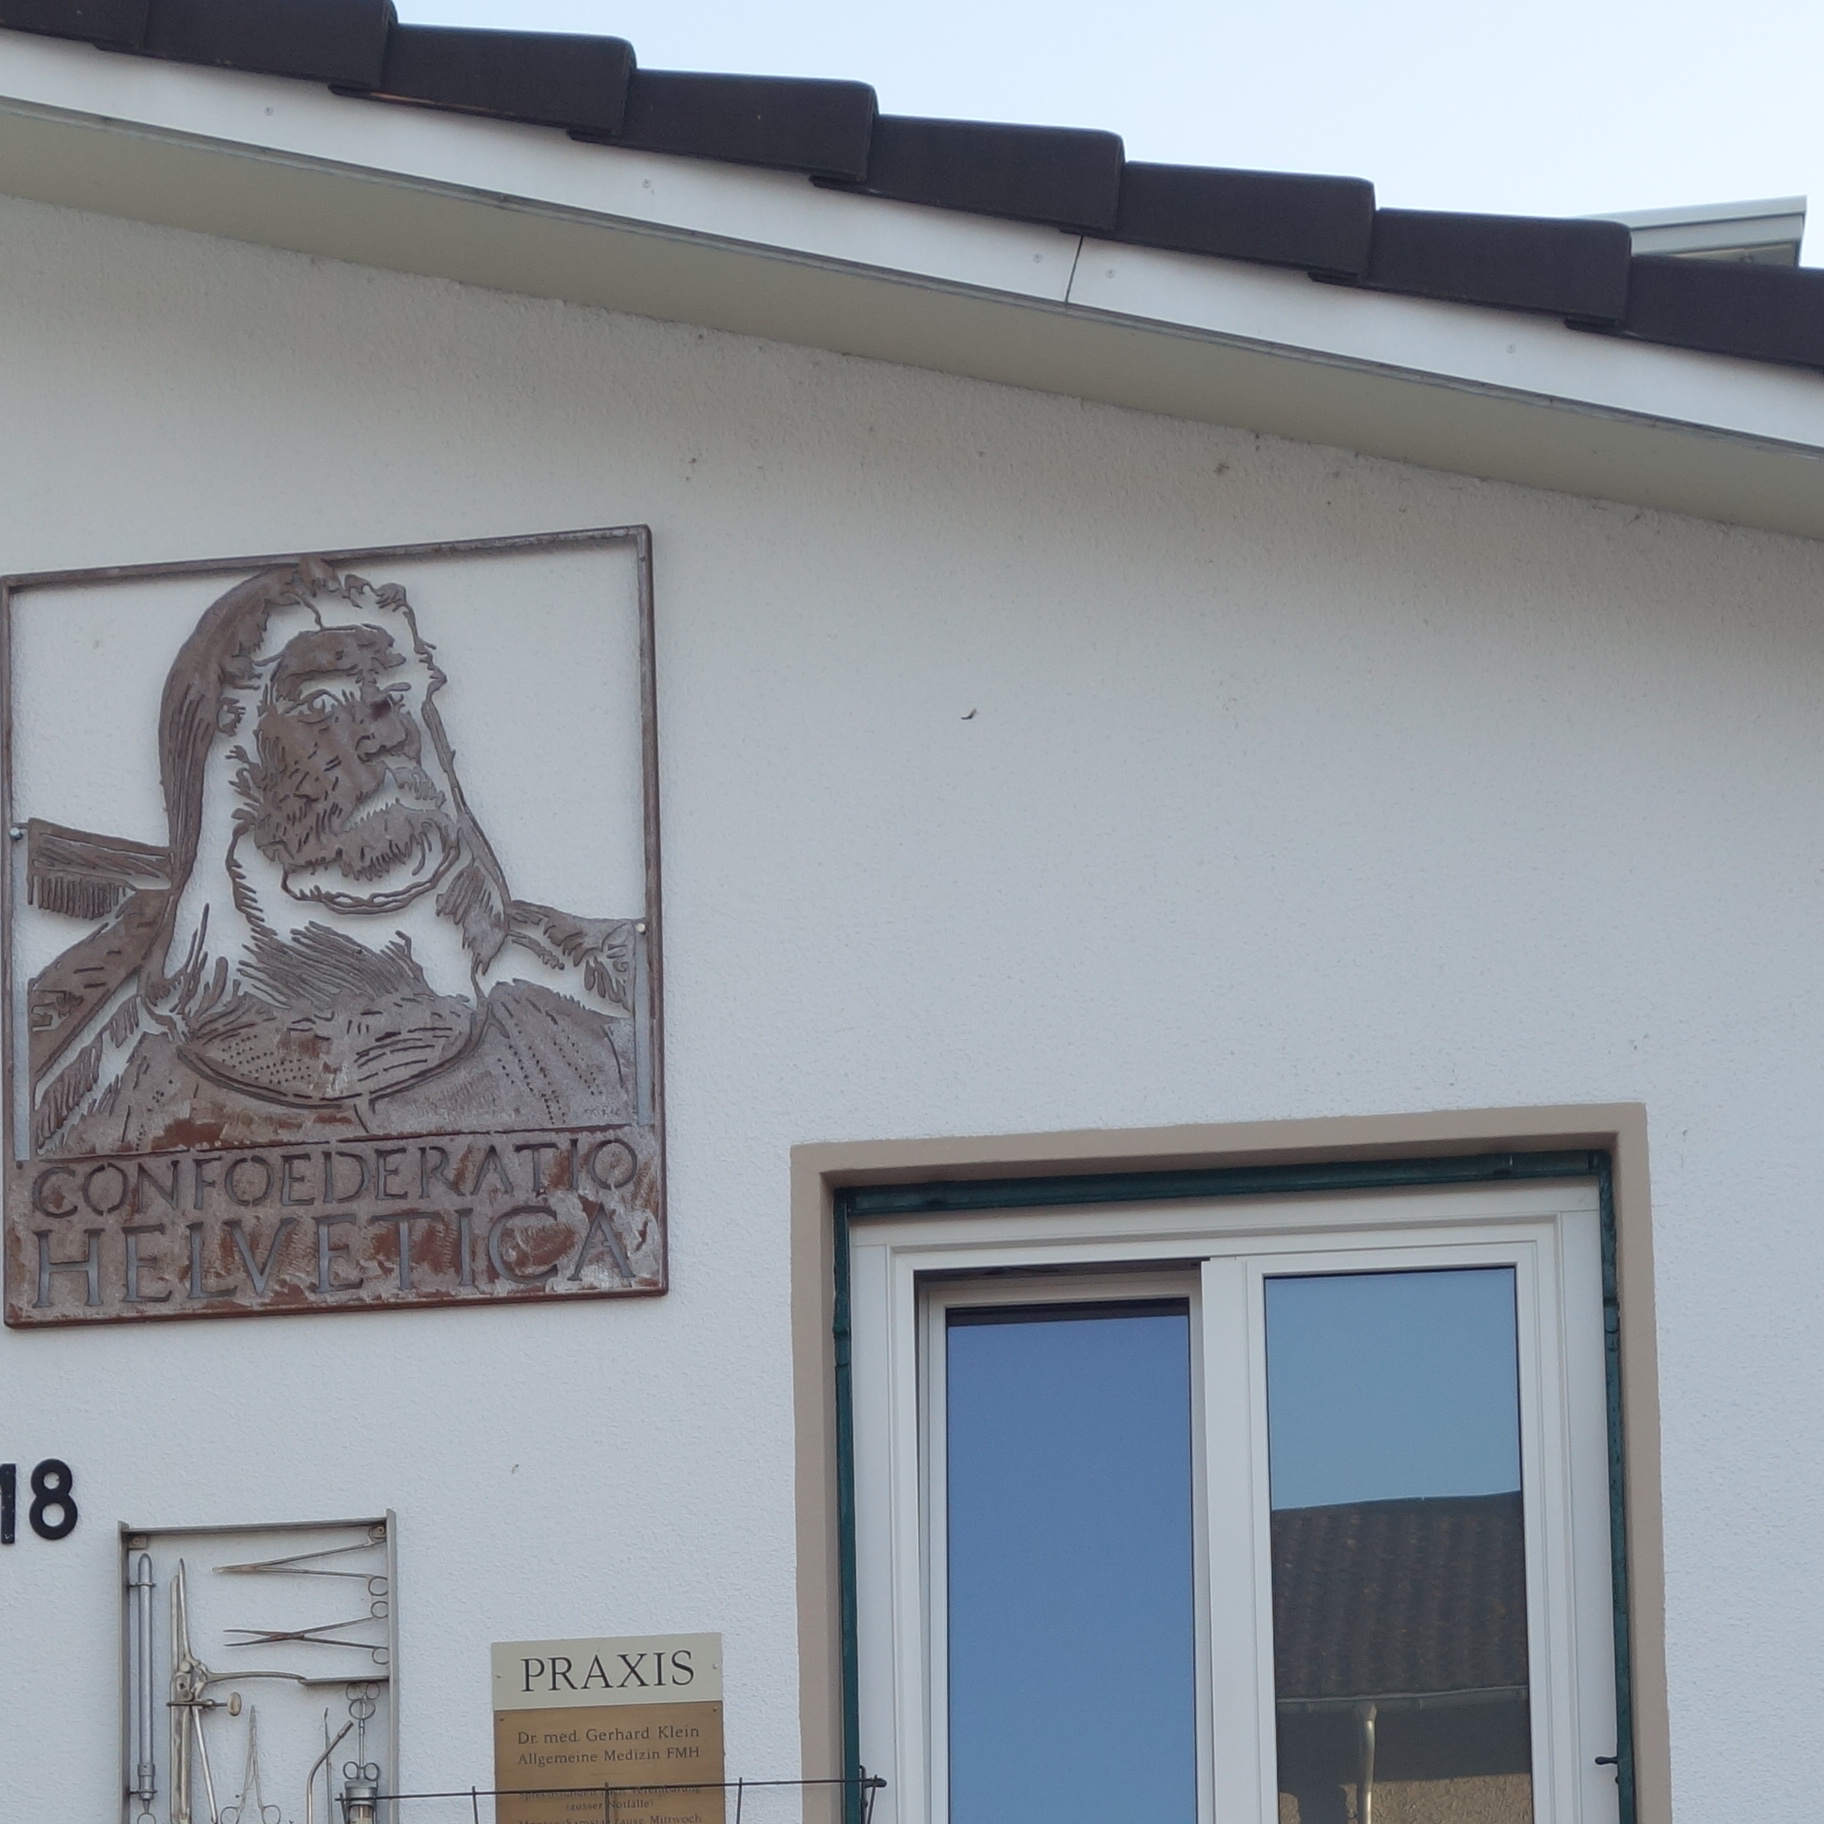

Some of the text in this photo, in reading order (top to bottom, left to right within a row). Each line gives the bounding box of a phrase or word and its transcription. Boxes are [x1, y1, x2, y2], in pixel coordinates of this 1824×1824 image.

[32, 1137, 638, 1218] CONFOEDERATIO
[32, 1205, 638, 1309] HELVETICA
[520, 1649, 695, 1693] PRAXIS
[517, 1731, 538, 1745] Dr.
[585, 1726, 650, 1742] Gerhard
[658, 1725, 700, 1739] Klein
[517, 1746, 700, 1768] Allgemeine Medizin FMH
